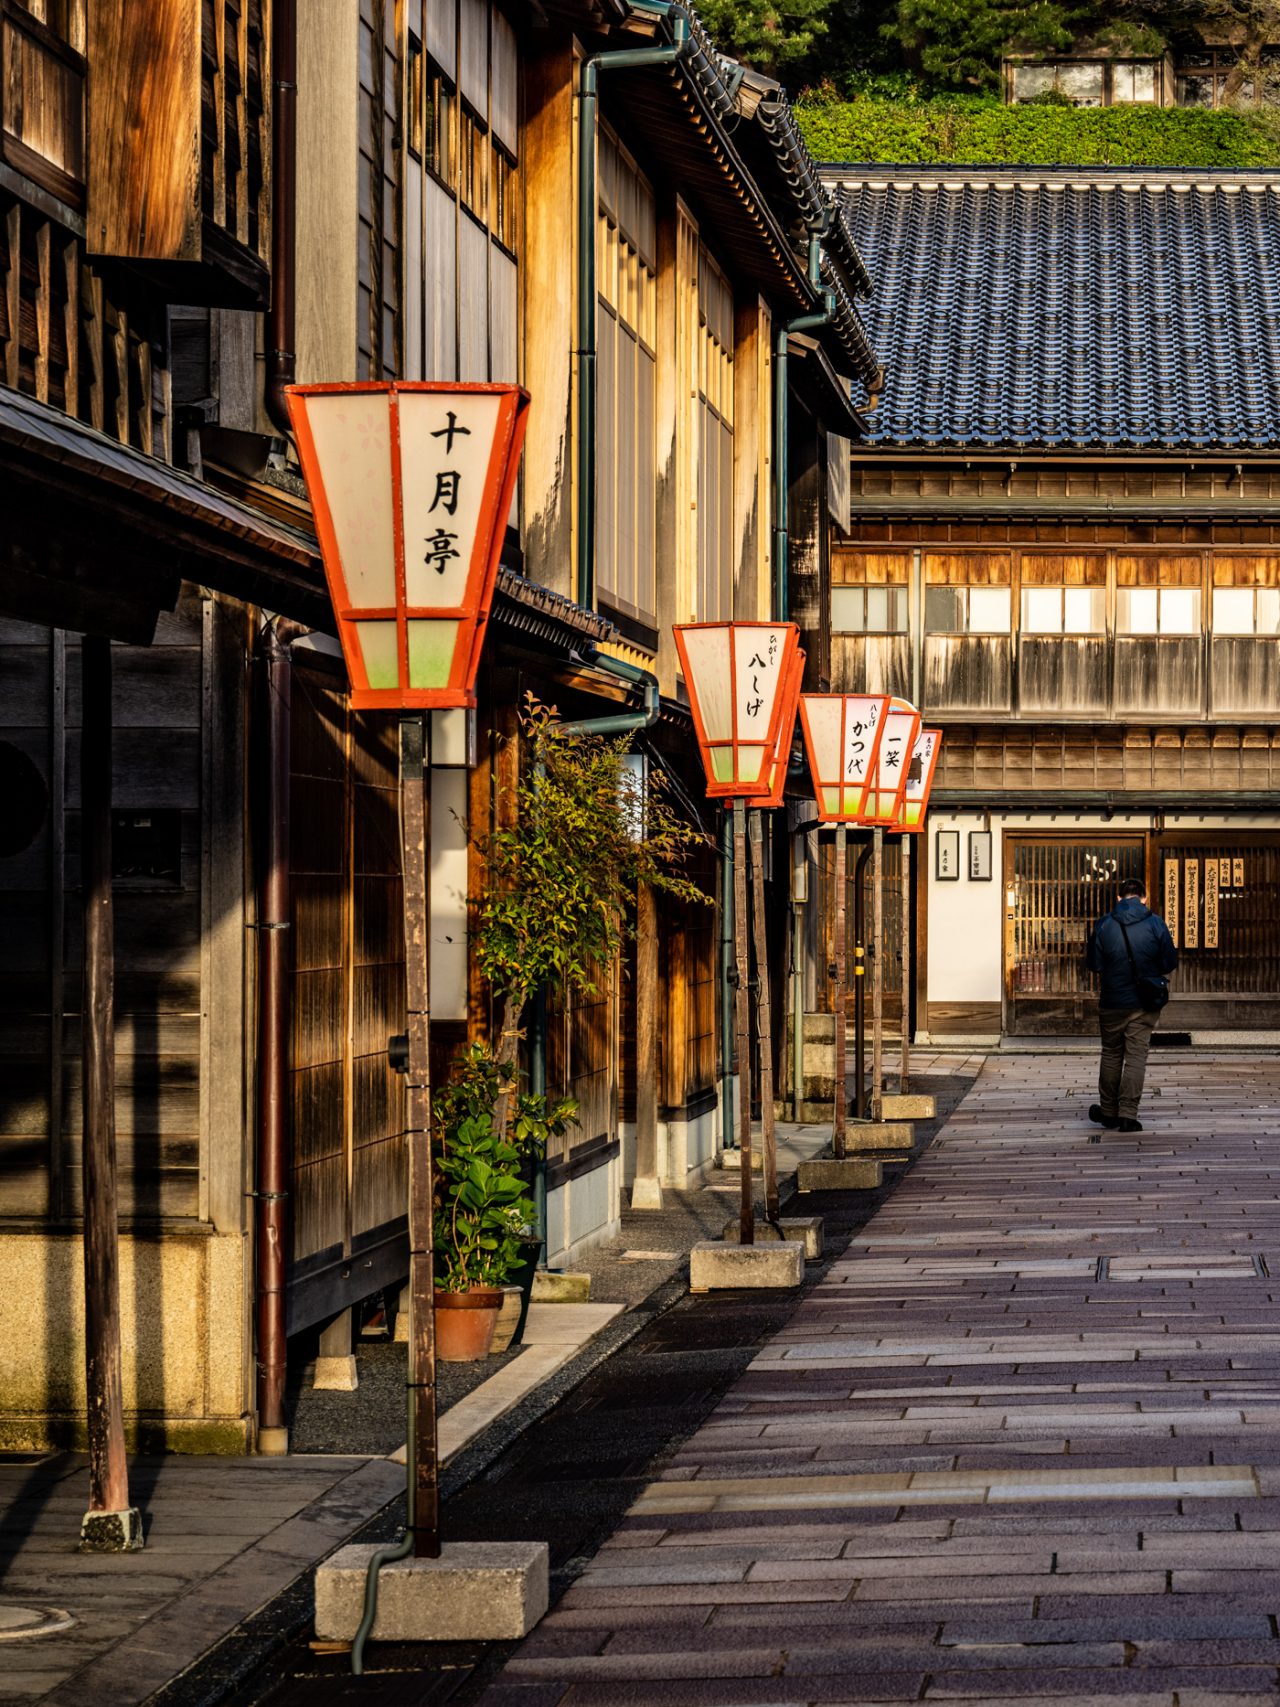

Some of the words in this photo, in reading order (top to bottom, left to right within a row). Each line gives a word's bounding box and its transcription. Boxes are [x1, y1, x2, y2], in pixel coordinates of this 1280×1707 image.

[424, 411, 471, 575] 十月亭
[768, 634, 778, 666] ひがし
[747, 653, 767, 718] 八しげ
[847, 720, 868, 775] かつ代
[885, 737, 901, 767] 一笑
